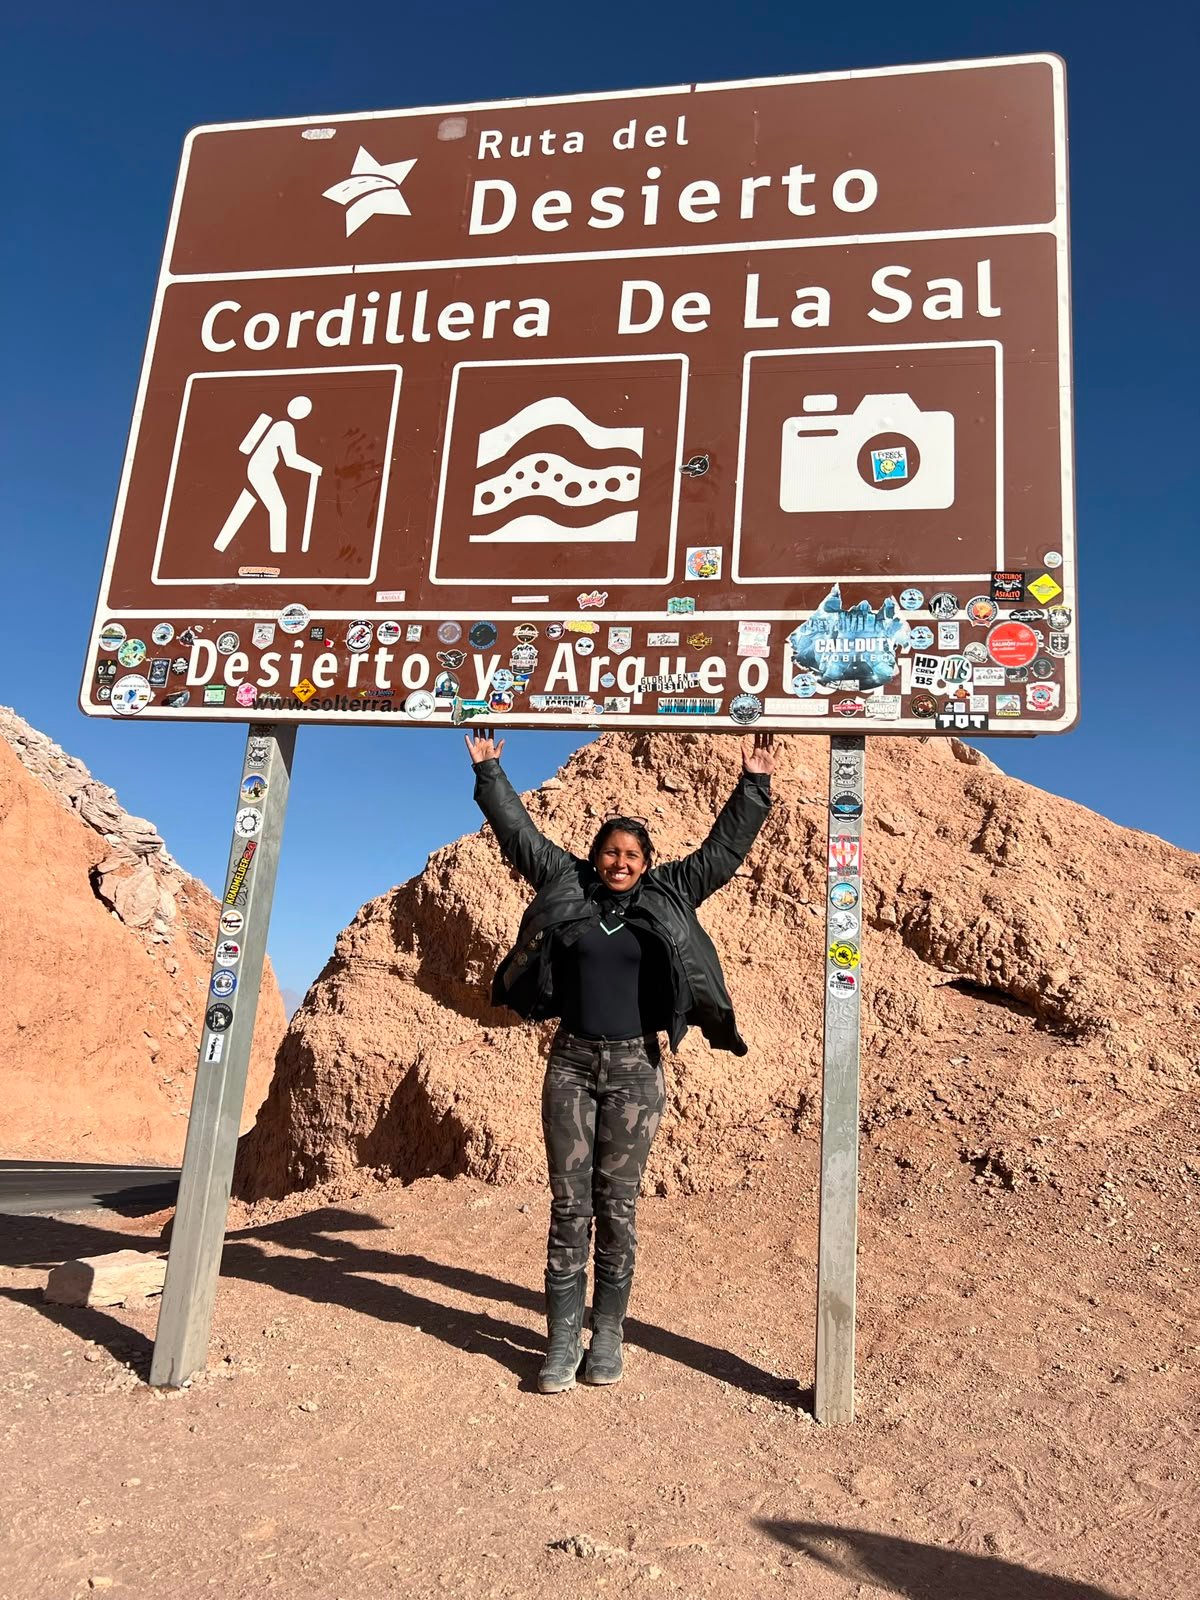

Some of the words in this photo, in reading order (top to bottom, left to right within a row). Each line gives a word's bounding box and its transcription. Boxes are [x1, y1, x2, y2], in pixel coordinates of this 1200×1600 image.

[477, 130, 584, 160] Ruta
[612, 115, 689, 150] del
[468, 164, 878, 236] Desierto
[201, 289, 550, 353] Cordillera
[617, 280, 711, 335] De
[743, 273, 831, 329] La
[867, 259, 1001, 323] Sal
[815, 639, 850, 653] CALL
[855, 639, 895, 653] DUTY
[821, 654, 877, 662] MOBILE
[916, 656, 938, 669] HD
[185, 637, 430, 691] Desierto
[473, 654, 503, 702] y
[916, 667, 935, 675] CREW
[941, 657, 972, 681] HYS
[640, 675, 673, 686] GLORIA
[677, 674, 689, 682] EN
[641, 684, 653, 693] SU
[656, 680, 695, 692] DESTINO
[914, 676, 933, 686] 135
[252, 694, 408, 713] www.solterra.c
